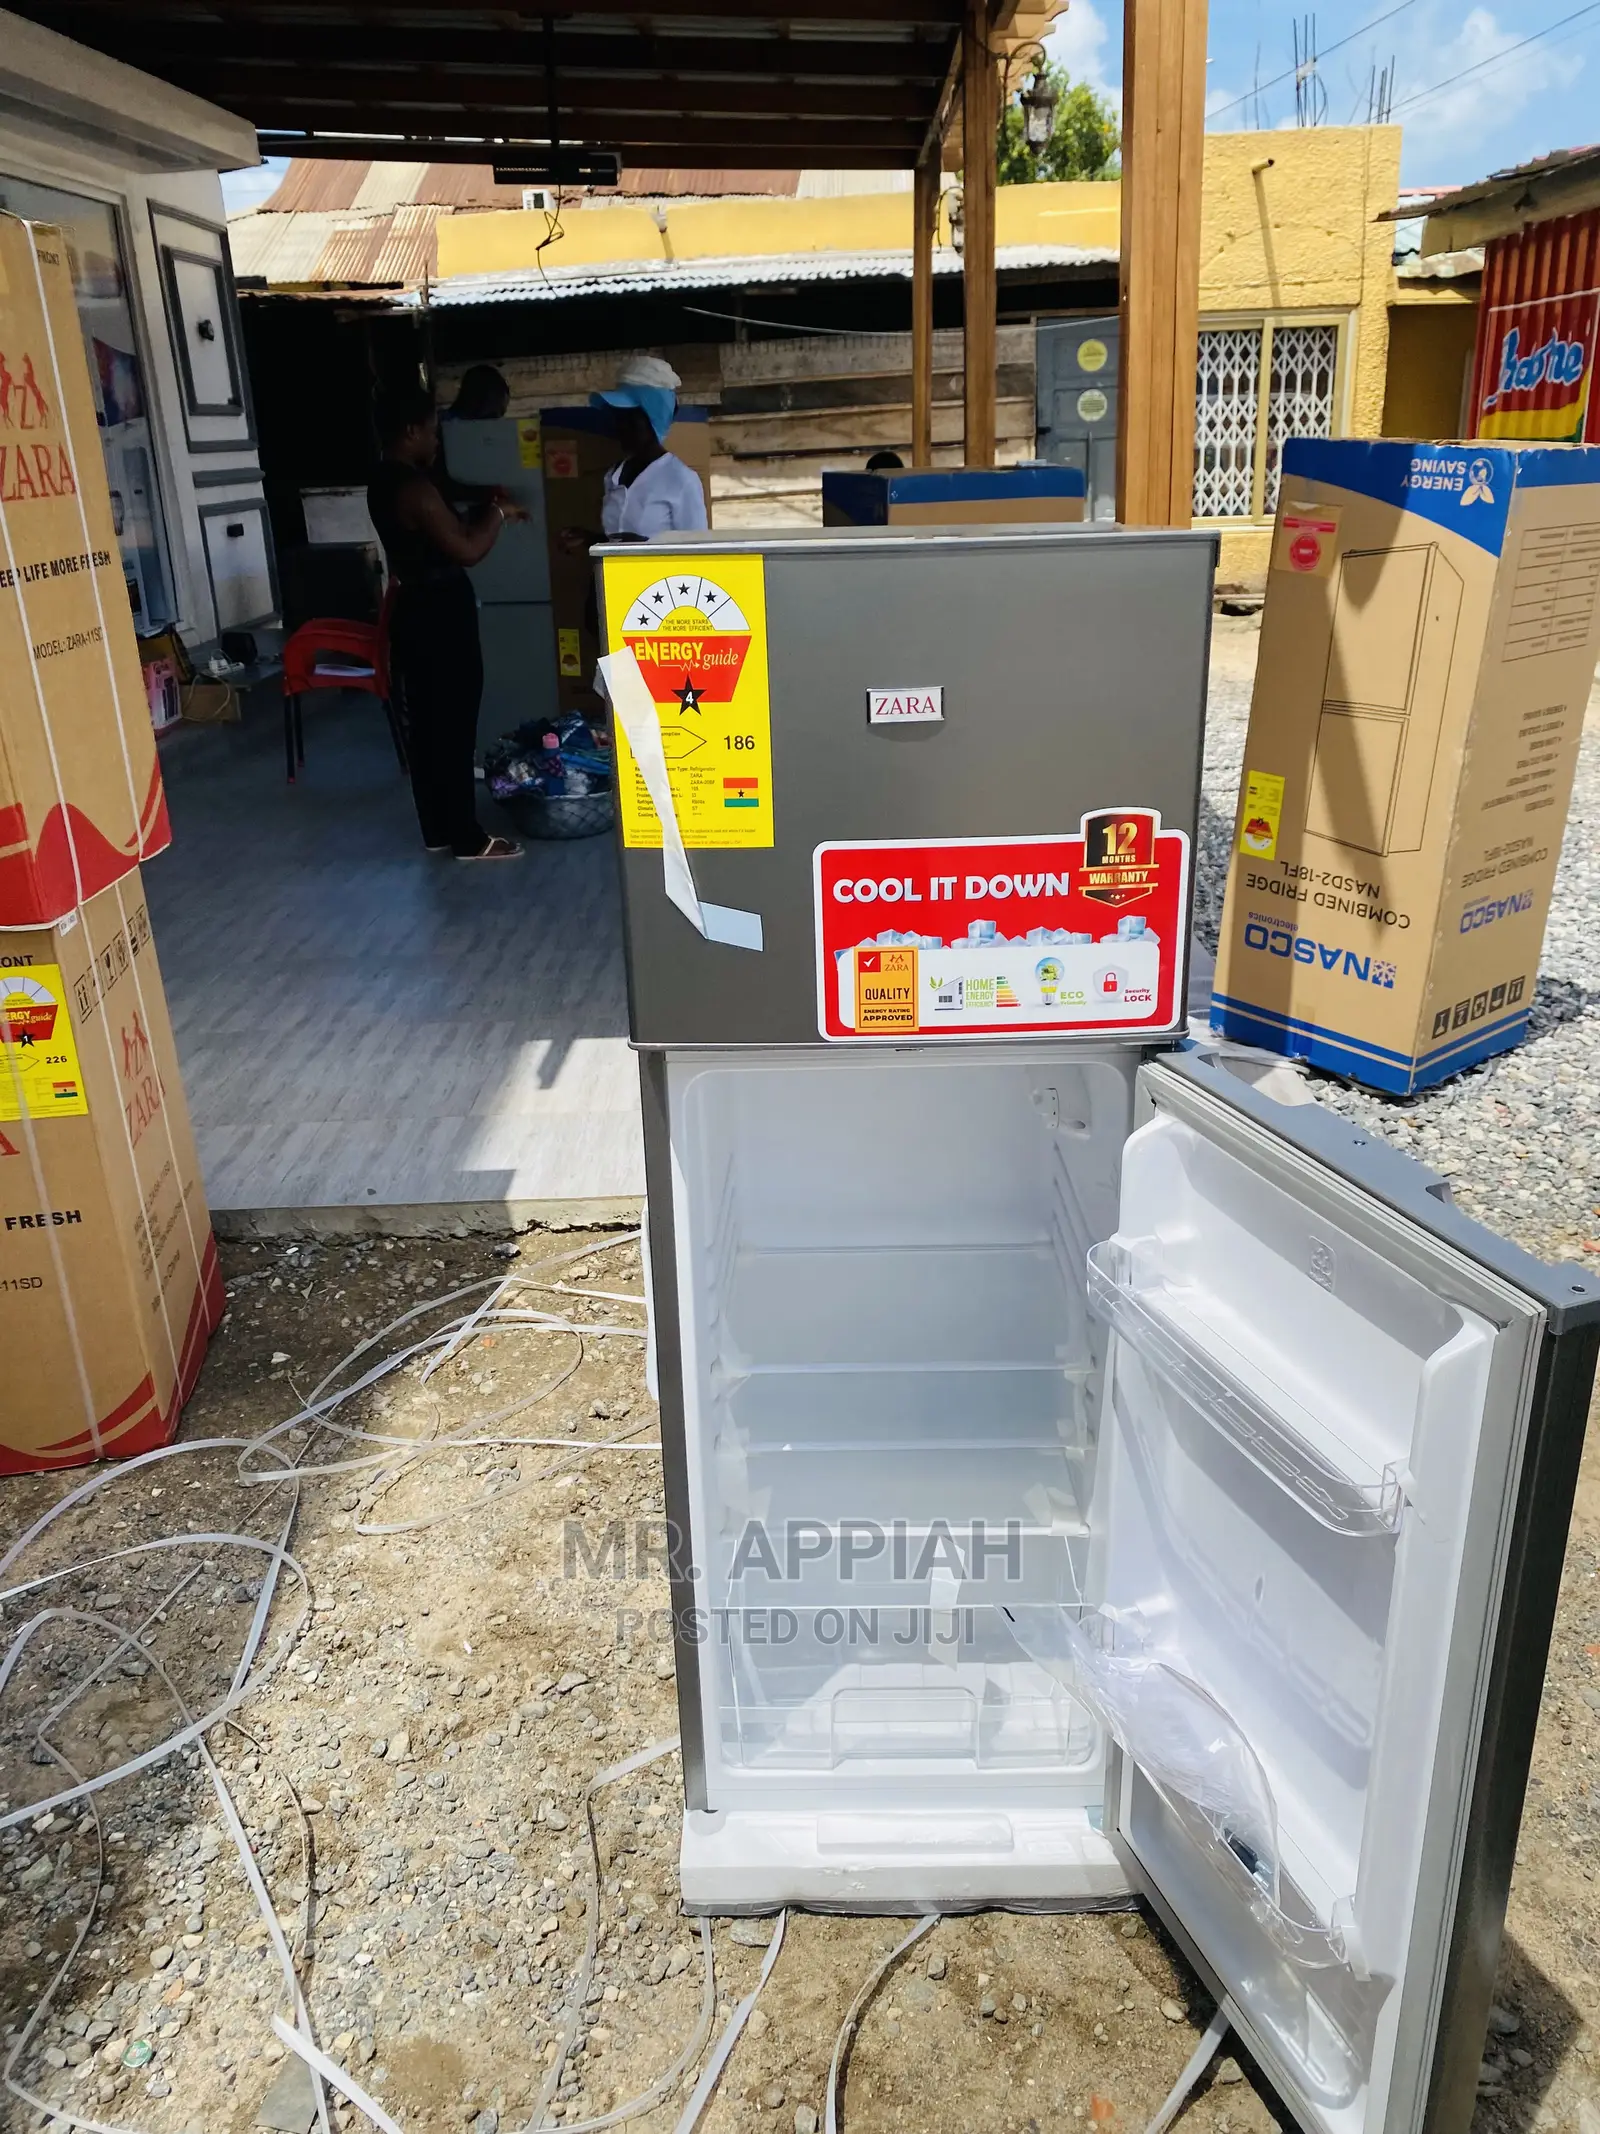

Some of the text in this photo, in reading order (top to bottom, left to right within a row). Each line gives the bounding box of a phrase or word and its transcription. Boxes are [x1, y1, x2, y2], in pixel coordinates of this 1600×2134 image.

[0, 442, 77, 501] ZARA
[1410, 458, 1467, 474] SAVING
[1400, 474, 1464, 492] ENERGY
[23, 562, 50, 582] LIFE
[49, 556, 79, 577] MORE
[635, 637, 739, 670] ENERGY guide
[685, 691, 694, 704] 4
[875, 696, 936, 715] ZARA
[723, 735, 756, 751] 186
[1102, 822, 1139, 855] 12
[1101, 855, 1136, 865] MONTHS
[1088, 869, 1149, 885] WARRANTY
[1280, 860, 1381, 899] NASD2-18FL
[832, 871, 1070, 903] COOL IT DOWN
[1246, 873, 1411, 929] COMBINED FRIDGE
[1248, 911, 1299, 932] electronics
[1460, 893, 1523, 934] NASCO
[1244, 923, 1371, 982] NASCO
[0, 955, 33, 968] ONT
[884, 963, 909, 972] ZARA
[965, 978, 995, 991] HOME
[865, 987, 910, 1000] QUALITY
[965, 991, 994, 1000] ENERGY
[1059, 991, 1085, 999] ECO
[1124, 994, 1152, 1003] LOCK
[862, 1014, 913, 1022] APPROVED
[23, 1035, 29, 1043] 1
[45, 1055, 68, 1064] 226
[5, 1209, 82, 1231] FRESH
[0, 1276, 43, 1292] -11SD
